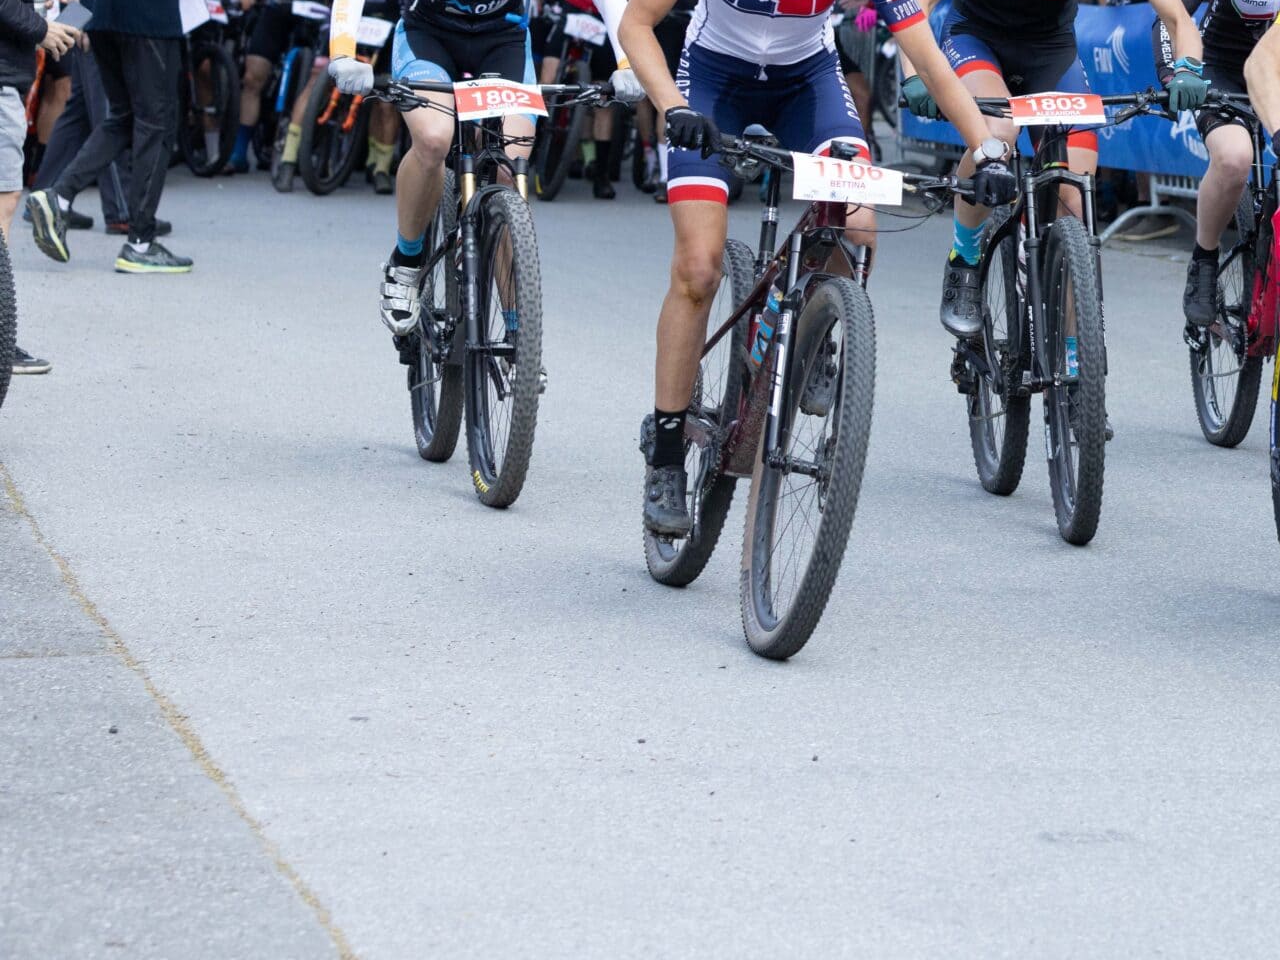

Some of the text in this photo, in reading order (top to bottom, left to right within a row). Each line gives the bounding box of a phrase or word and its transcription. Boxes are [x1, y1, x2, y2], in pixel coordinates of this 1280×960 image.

[471, 90, 531, 107] 1802
[1026, 97, 1087, 112] 1803
[830, 180, 866, 190] BETTINA
